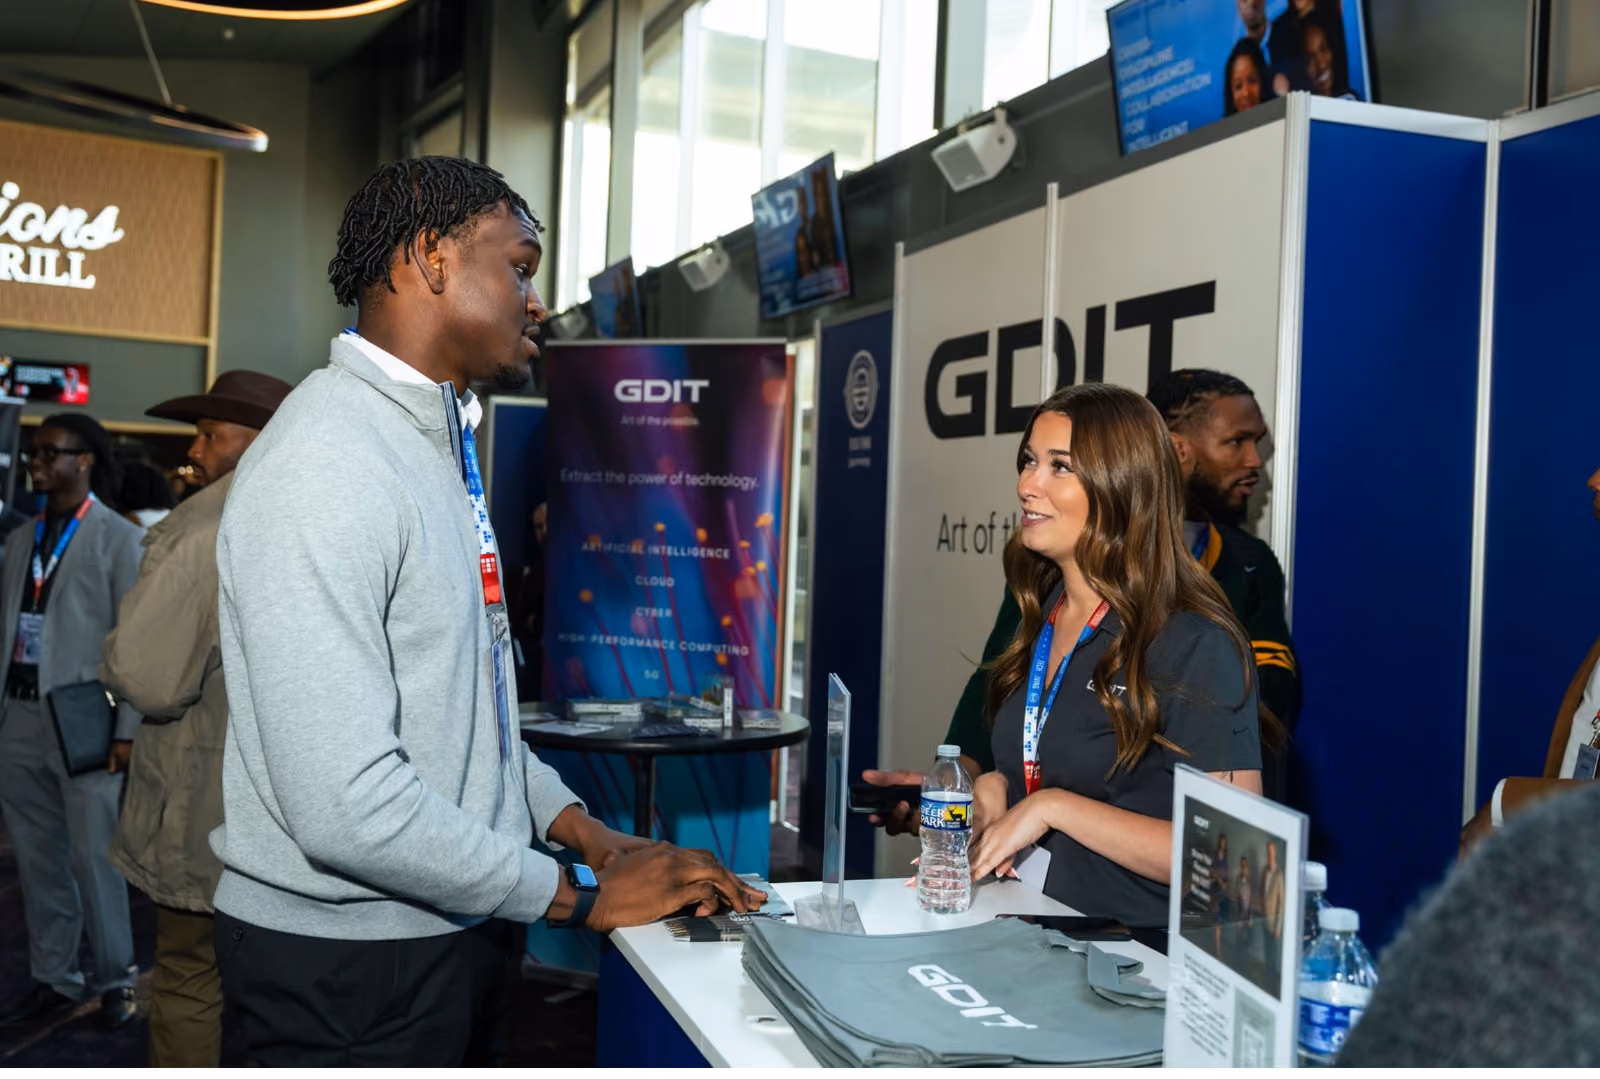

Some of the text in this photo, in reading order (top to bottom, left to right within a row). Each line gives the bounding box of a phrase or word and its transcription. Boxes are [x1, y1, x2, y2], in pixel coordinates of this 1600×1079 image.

[924, 280, 1216, 440] GDIT
[614, 379, 710, 403] GDIT
[560, 467, 603, 484] Extract
[605, 469, 626, 484] the
[627, 473, 667, 489] power
[669, 471, 683, 486] of
[936, 512, 967, 553] Art
[974, 510, 996, 555] of
[581, 542, 730, 560] ARTIFICIAL INTELLIGENCE
[634, 575, 675, 588] CLOUD
[635, 606, 673, 618] CYBER
[679, 641, 750, 657] COMPUTING
[1086, 679, 1127, 697] GIT
[908, 964, 1039, 1030] GDIT
